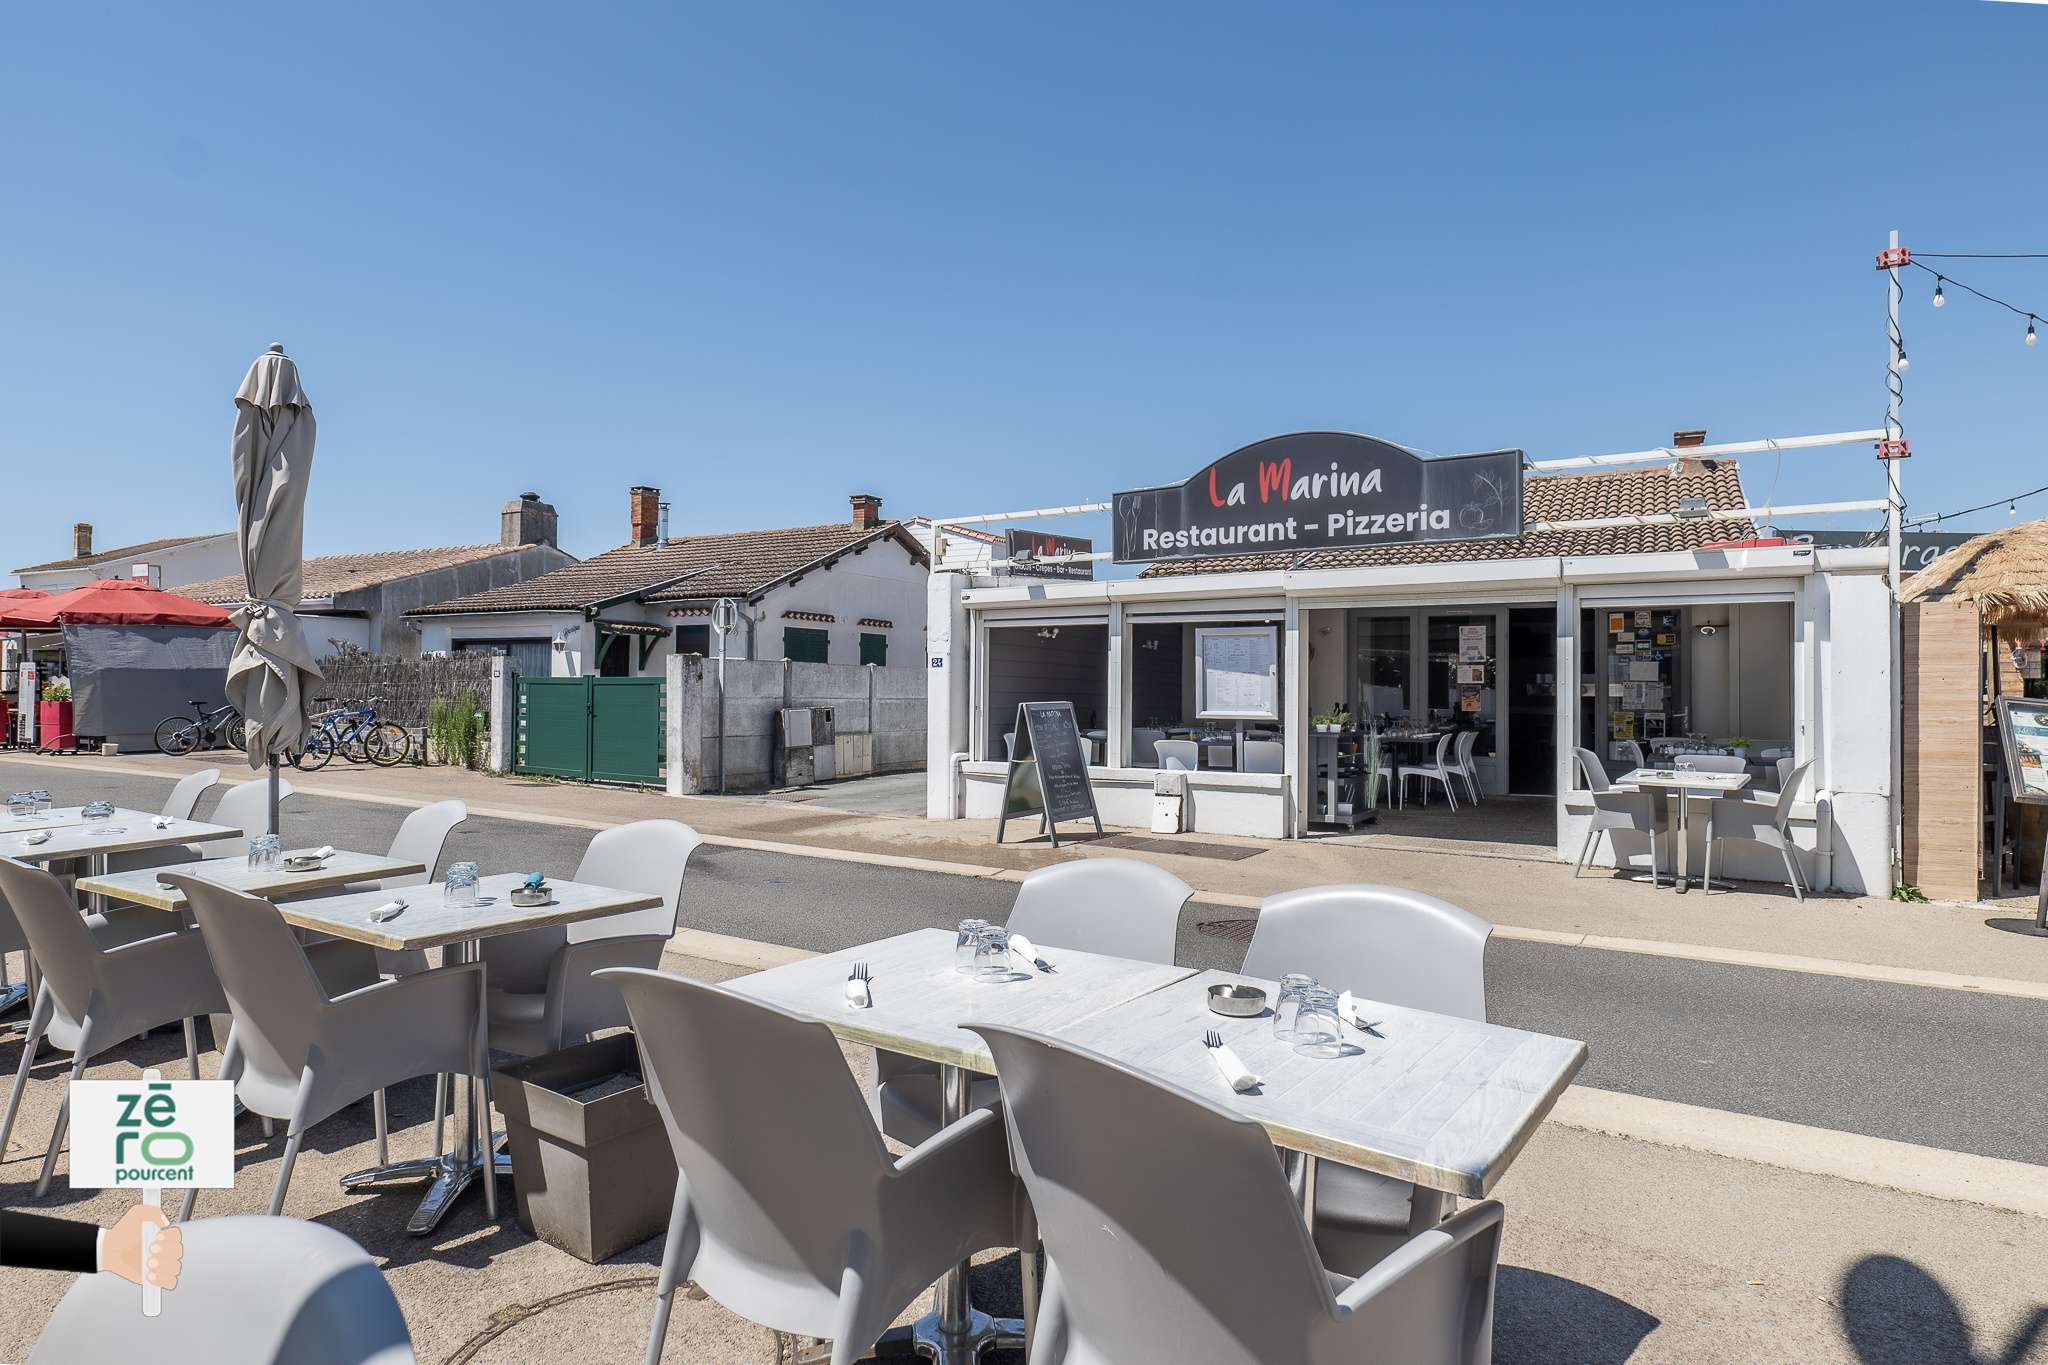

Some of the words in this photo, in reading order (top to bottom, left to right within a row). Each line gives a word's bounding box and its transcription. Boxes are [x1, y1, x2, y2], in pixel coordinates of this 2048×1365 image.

[1208, 466, 1246, 508] La
[1258, 456, 1383, 504] Marina
[1142, 517, 1297, 550] Restaurant
[1327, 504, 1451, 537] Pizzeria
[1056, 565, 1065, 573] Bar
[1068, 566, 1092, 576] Restaurant
